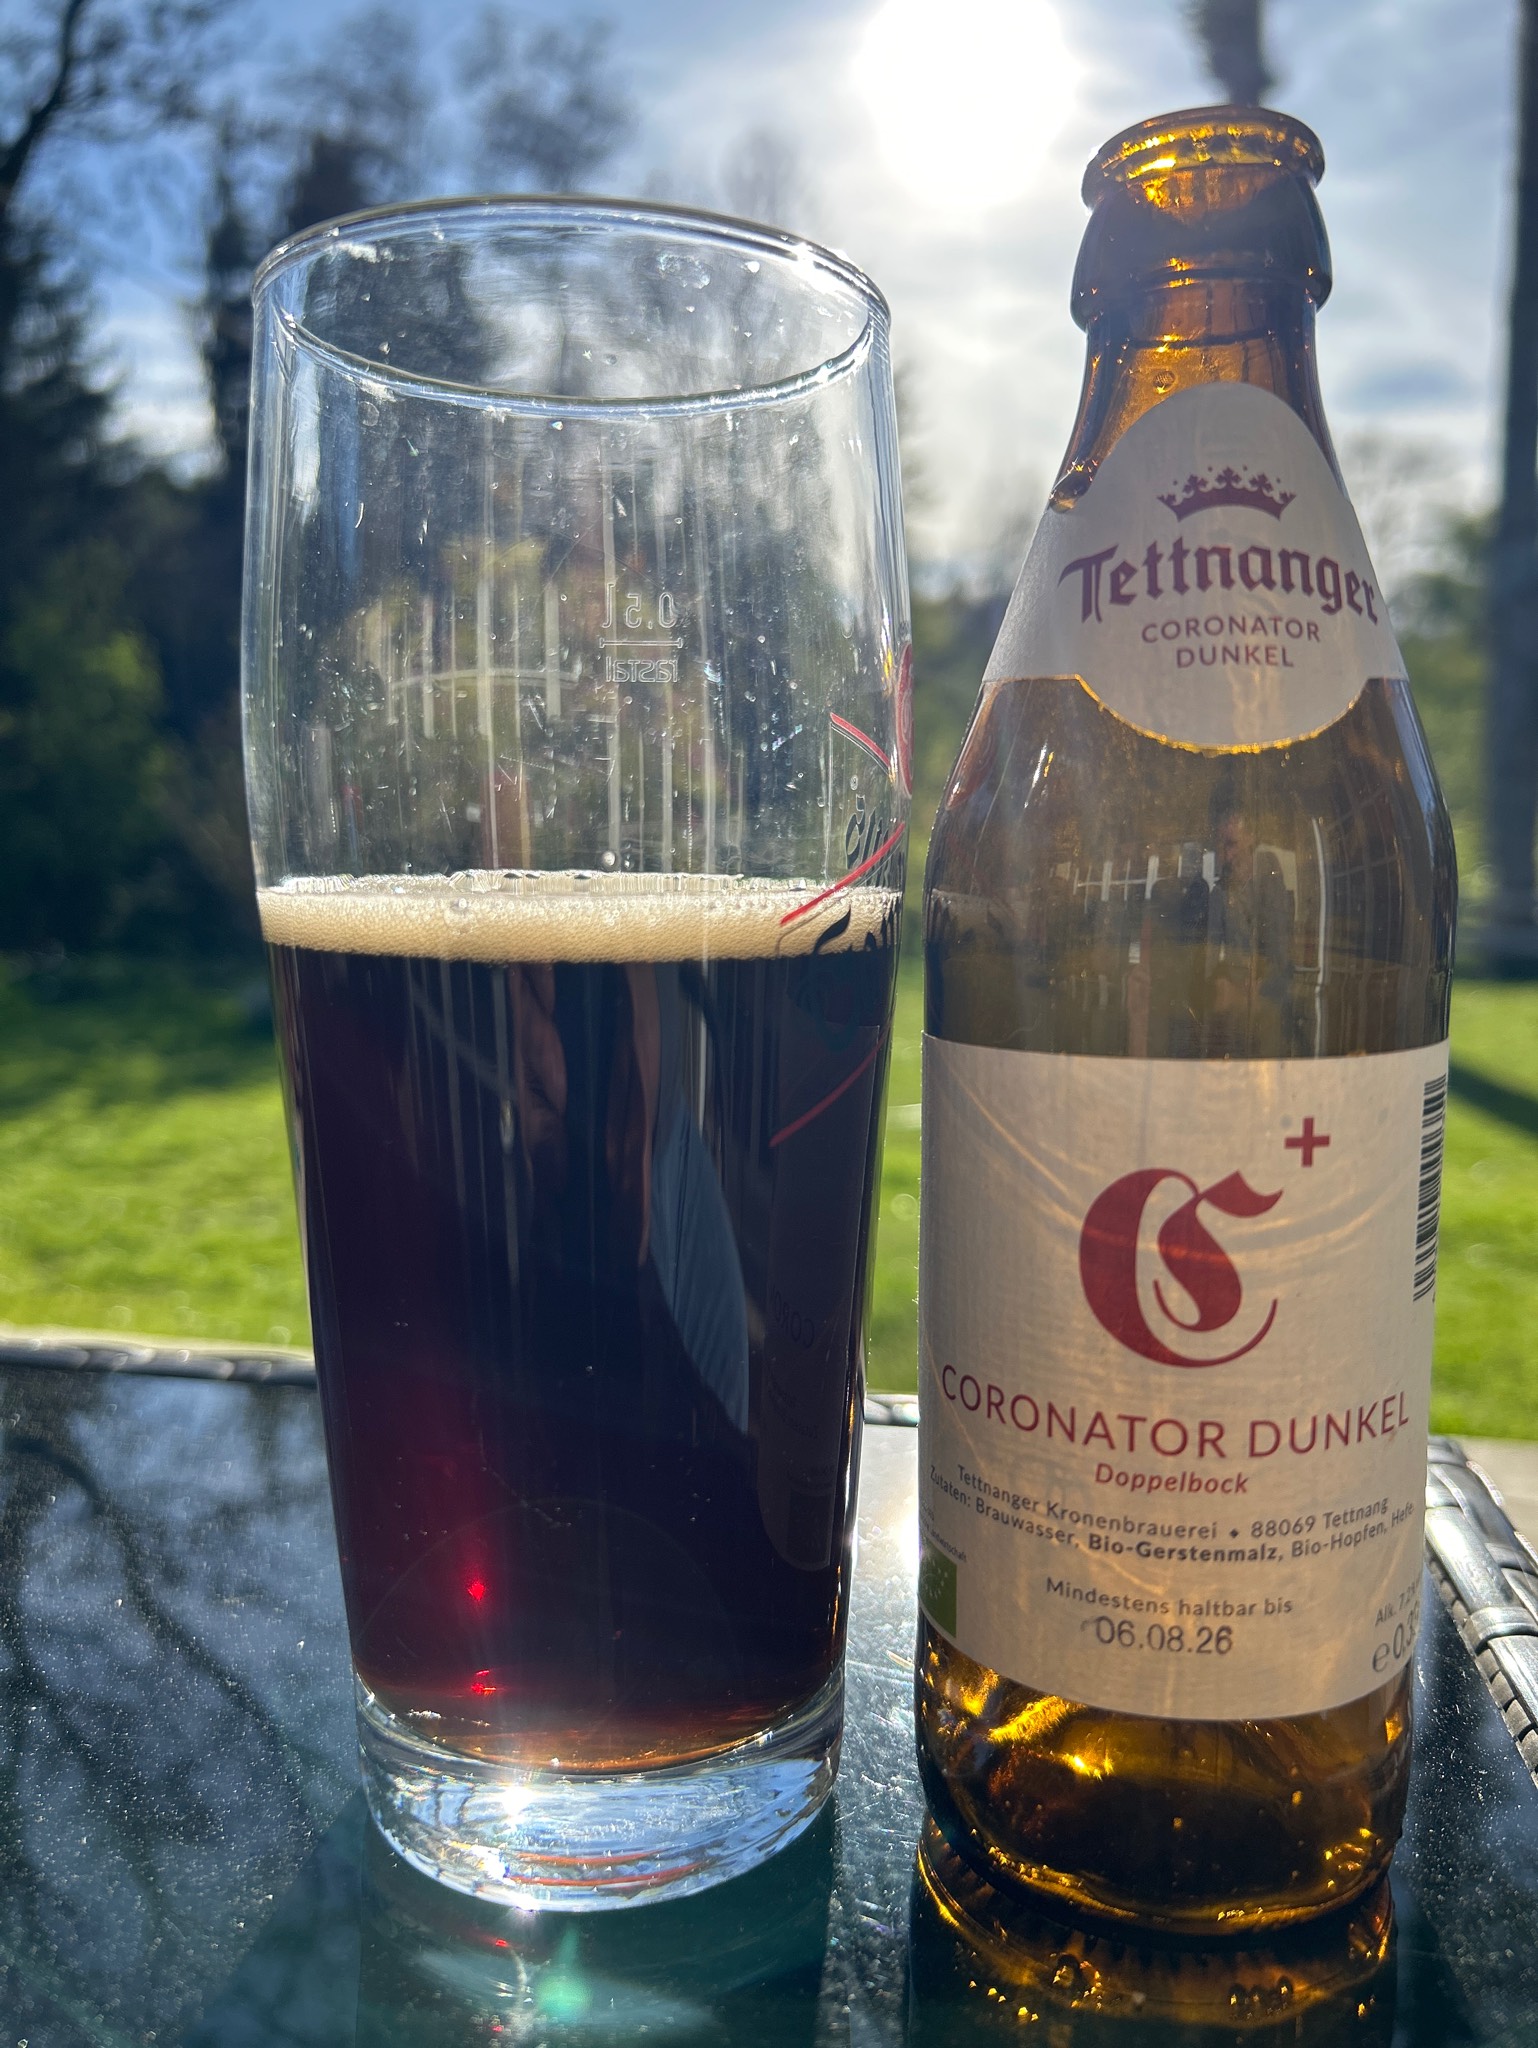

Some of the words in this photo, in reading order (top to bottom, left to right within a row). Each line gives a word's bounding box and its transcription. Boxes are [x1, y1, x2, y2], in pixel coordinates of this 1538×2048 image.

[1057, 536, 1378, 625] Tettnanger
[1141, 614, 1321, 643] CORONATOR
[1176, 644, 1295, 669] DUNKEL
[942, 1364, 1226, 1459] CORONATOR
[1249, 1391, 1409, 1458] DUNKEL
[1095, 1463, 1249, 1494] Doppelbock
[930, 1465, 971, 1508] Zutaten:
[976, 1497, 1079, 1549] Brauwasser,
[1088, 1533, 1283, 1562] Bio-Gerstenmalz,
[1291, 1522, 1387, 1558] Bio-Hopfen,
[1391, 1502, 1414, 1526] Hefe
[957, 1464, 1039, 1513] Tettnanger
[1046, 1500, 1217, 1540] Kronenbrauerei
[1251, 1515, 1316, 1538] 88069
[1322, 1498, 1389, 1530] Tettnang
[1046, 1577, 1169, 1615] Mindestens
[1178, 1598, 1256, 1617] haltbar
[1264, 1598, 1293, 1615] bis
[1095, 1616, 1234, 1655] 06.08.26
